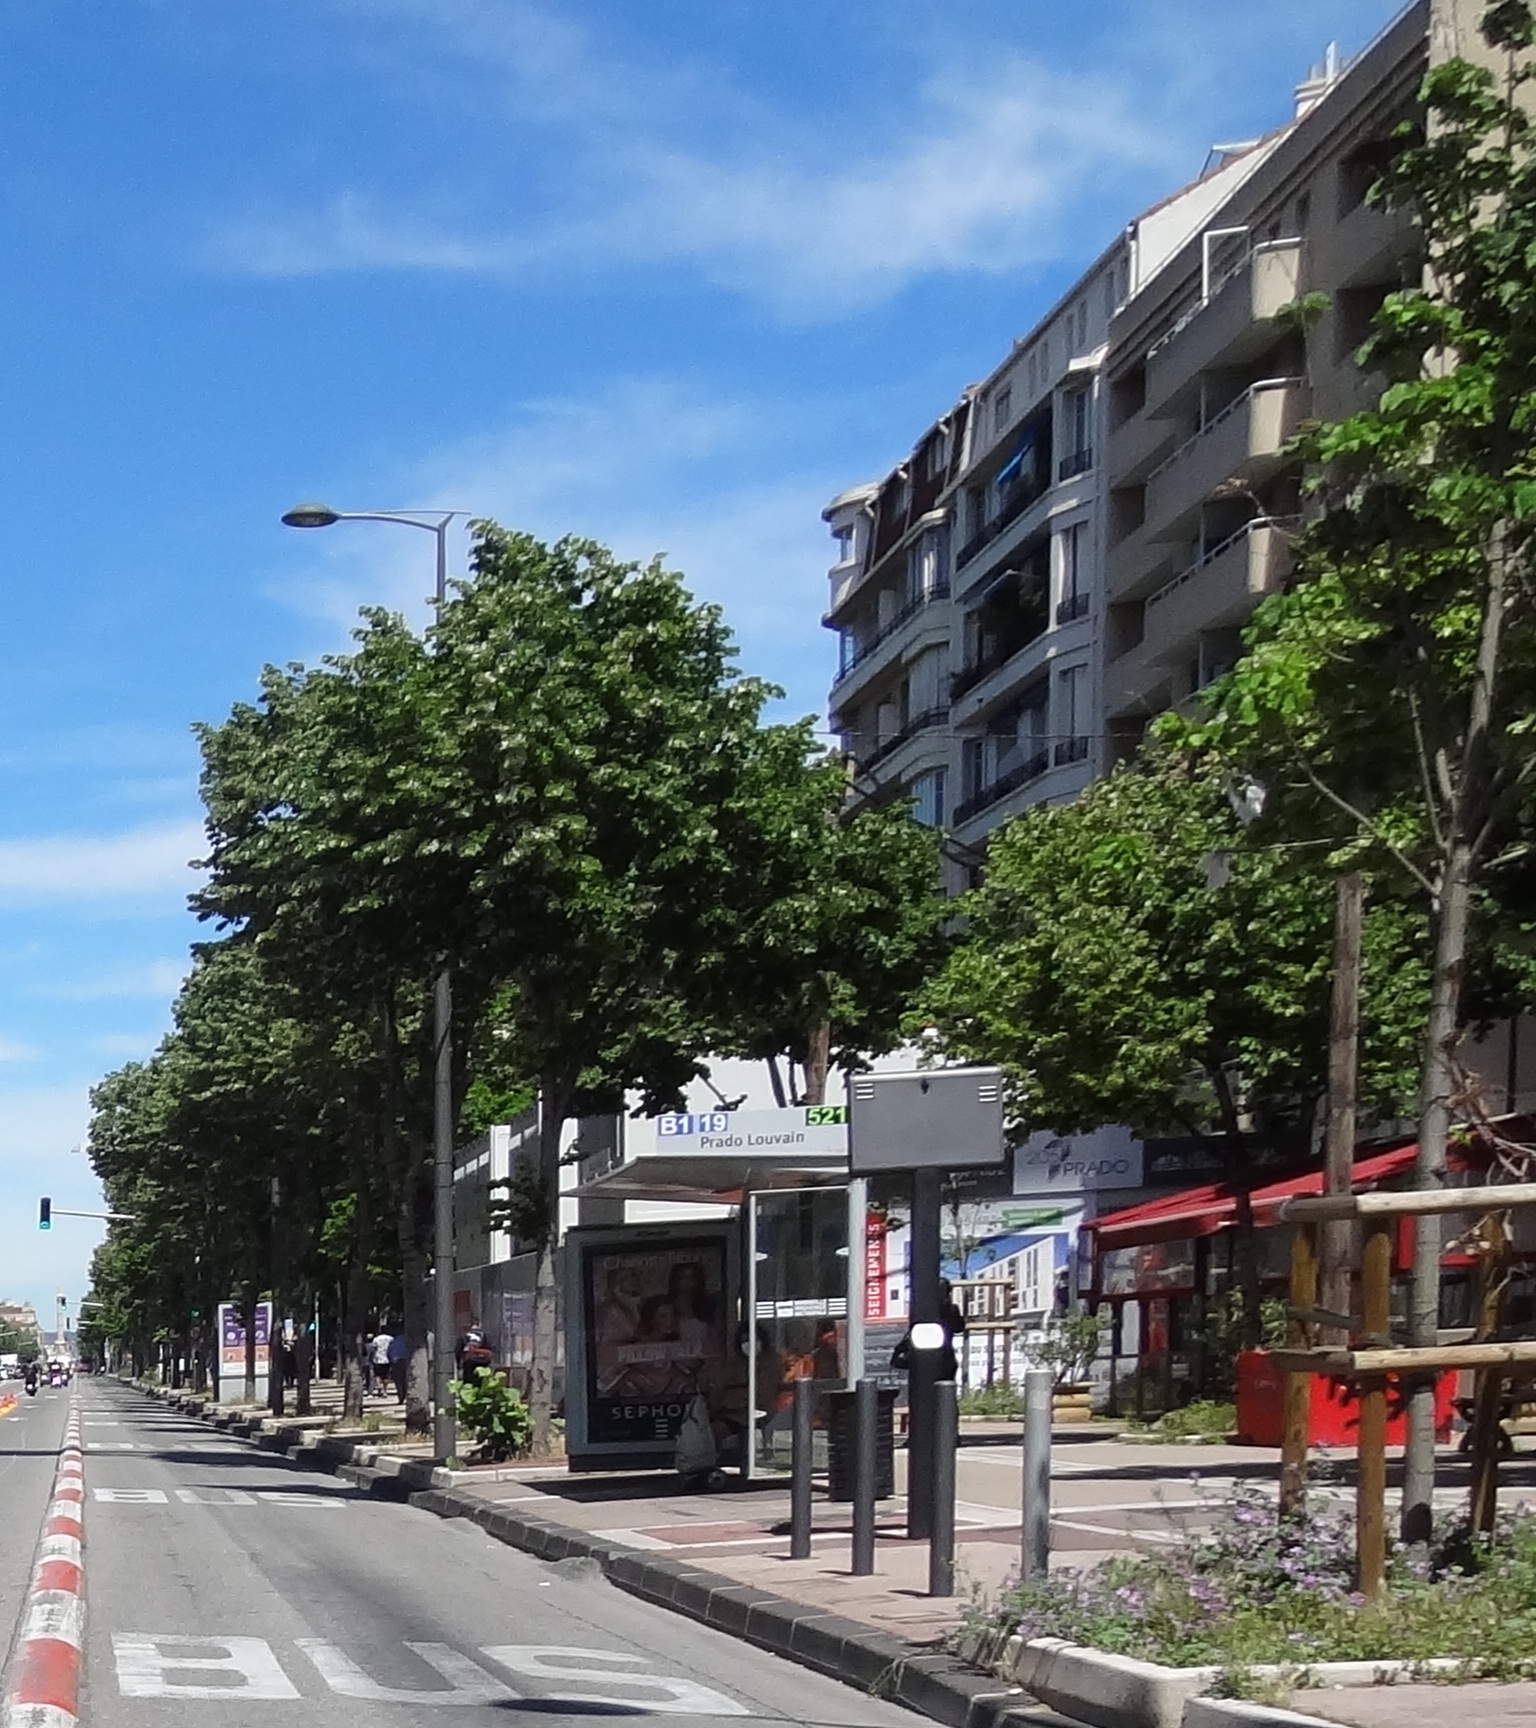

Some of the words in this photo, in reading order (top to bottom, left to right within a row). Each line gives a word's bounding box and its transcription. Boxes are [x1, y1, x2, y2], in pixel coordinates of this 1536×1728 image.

[660, 1115, 689, 1135] B1
[700, 1114, 726, 1132] 19
[808, 1107, 847, 1125] 521
[700, 1134, 743, 1149] Prado
[747, 1131, 805, 1147] Louvain
[1063, 1159, 1130, 1176] PRADO
[866, 1223, 880, 1316] SEIGNEMENS
[612, 1403, 689, 1420] SEPHO
[92, 1487, 347, 1508] BUS
[111, 1632, 752, 1716] BUS
